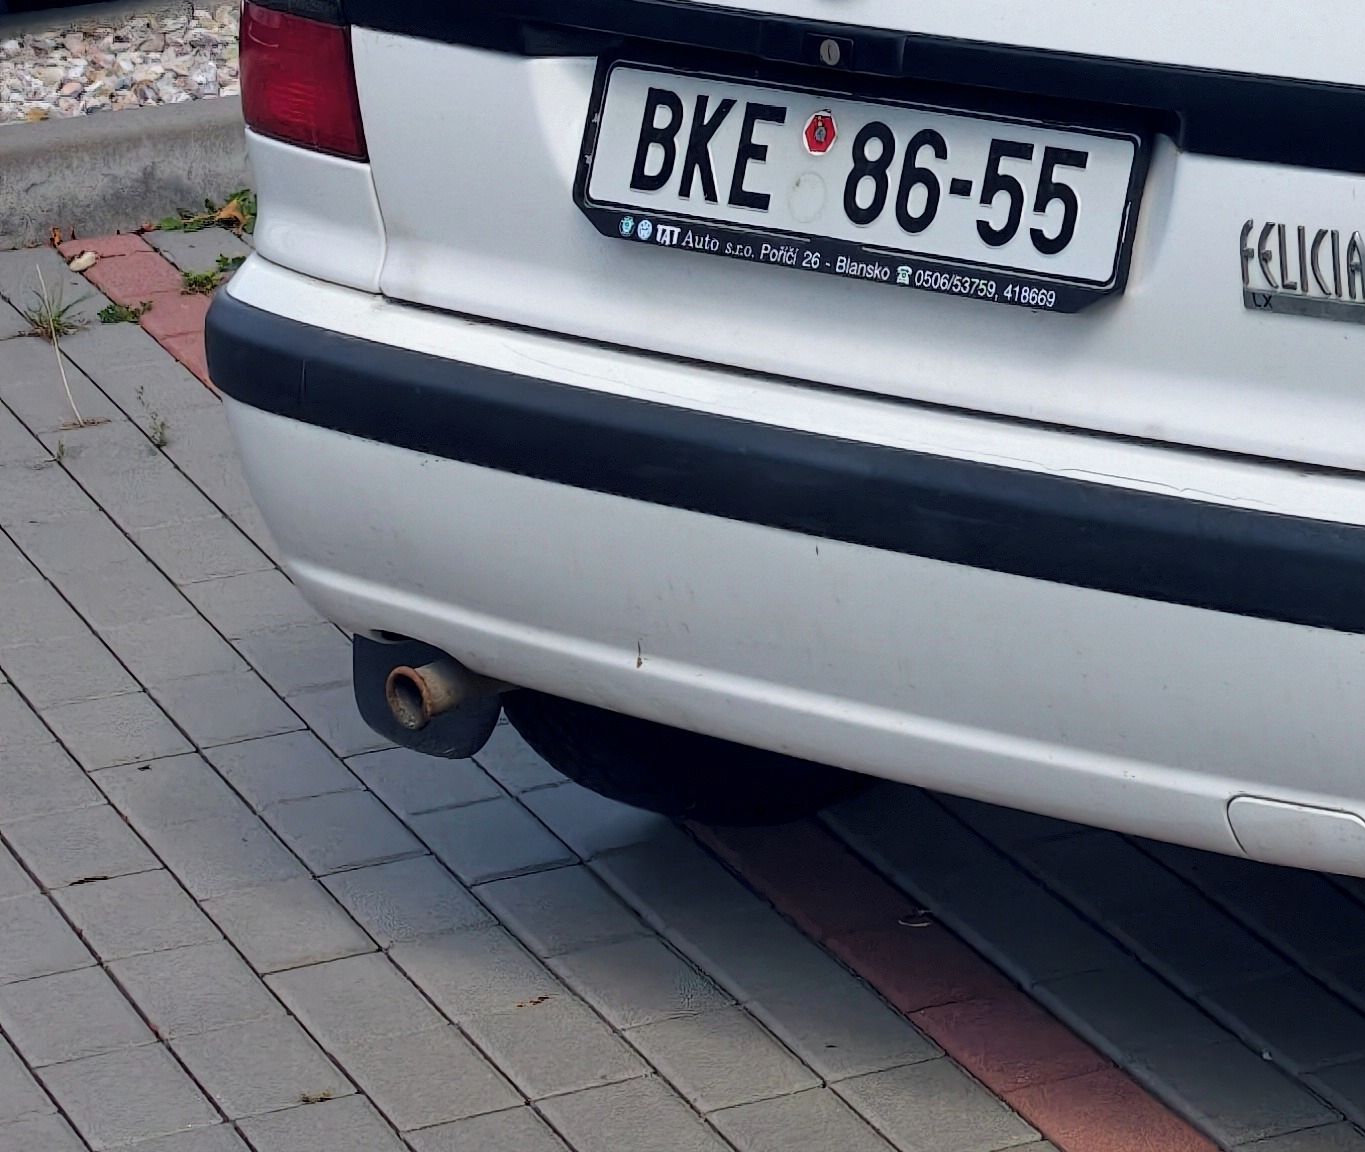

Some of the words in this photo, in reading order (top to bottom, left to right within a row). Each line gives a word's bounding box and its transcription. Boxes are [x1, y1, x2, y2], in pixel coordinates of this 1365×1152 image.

[629, 86, 788, 212] BKE
[842, 120, 1089, 255] 86-55
[656, 223, 682, 246] TAT
[682, 229, 720, 252] Auto
[725, 240, 755, 259] s.r.o.
[760, 242, 799, 266] Poříčí
[802, 250, 821, 269] 26
[835, 256, 891, 281] Blansko
[914, 269, 999, 302] 0506/53759,
[1003, 283, 1056, 307] 418669
[1252, 292, 1273, 309] LX
